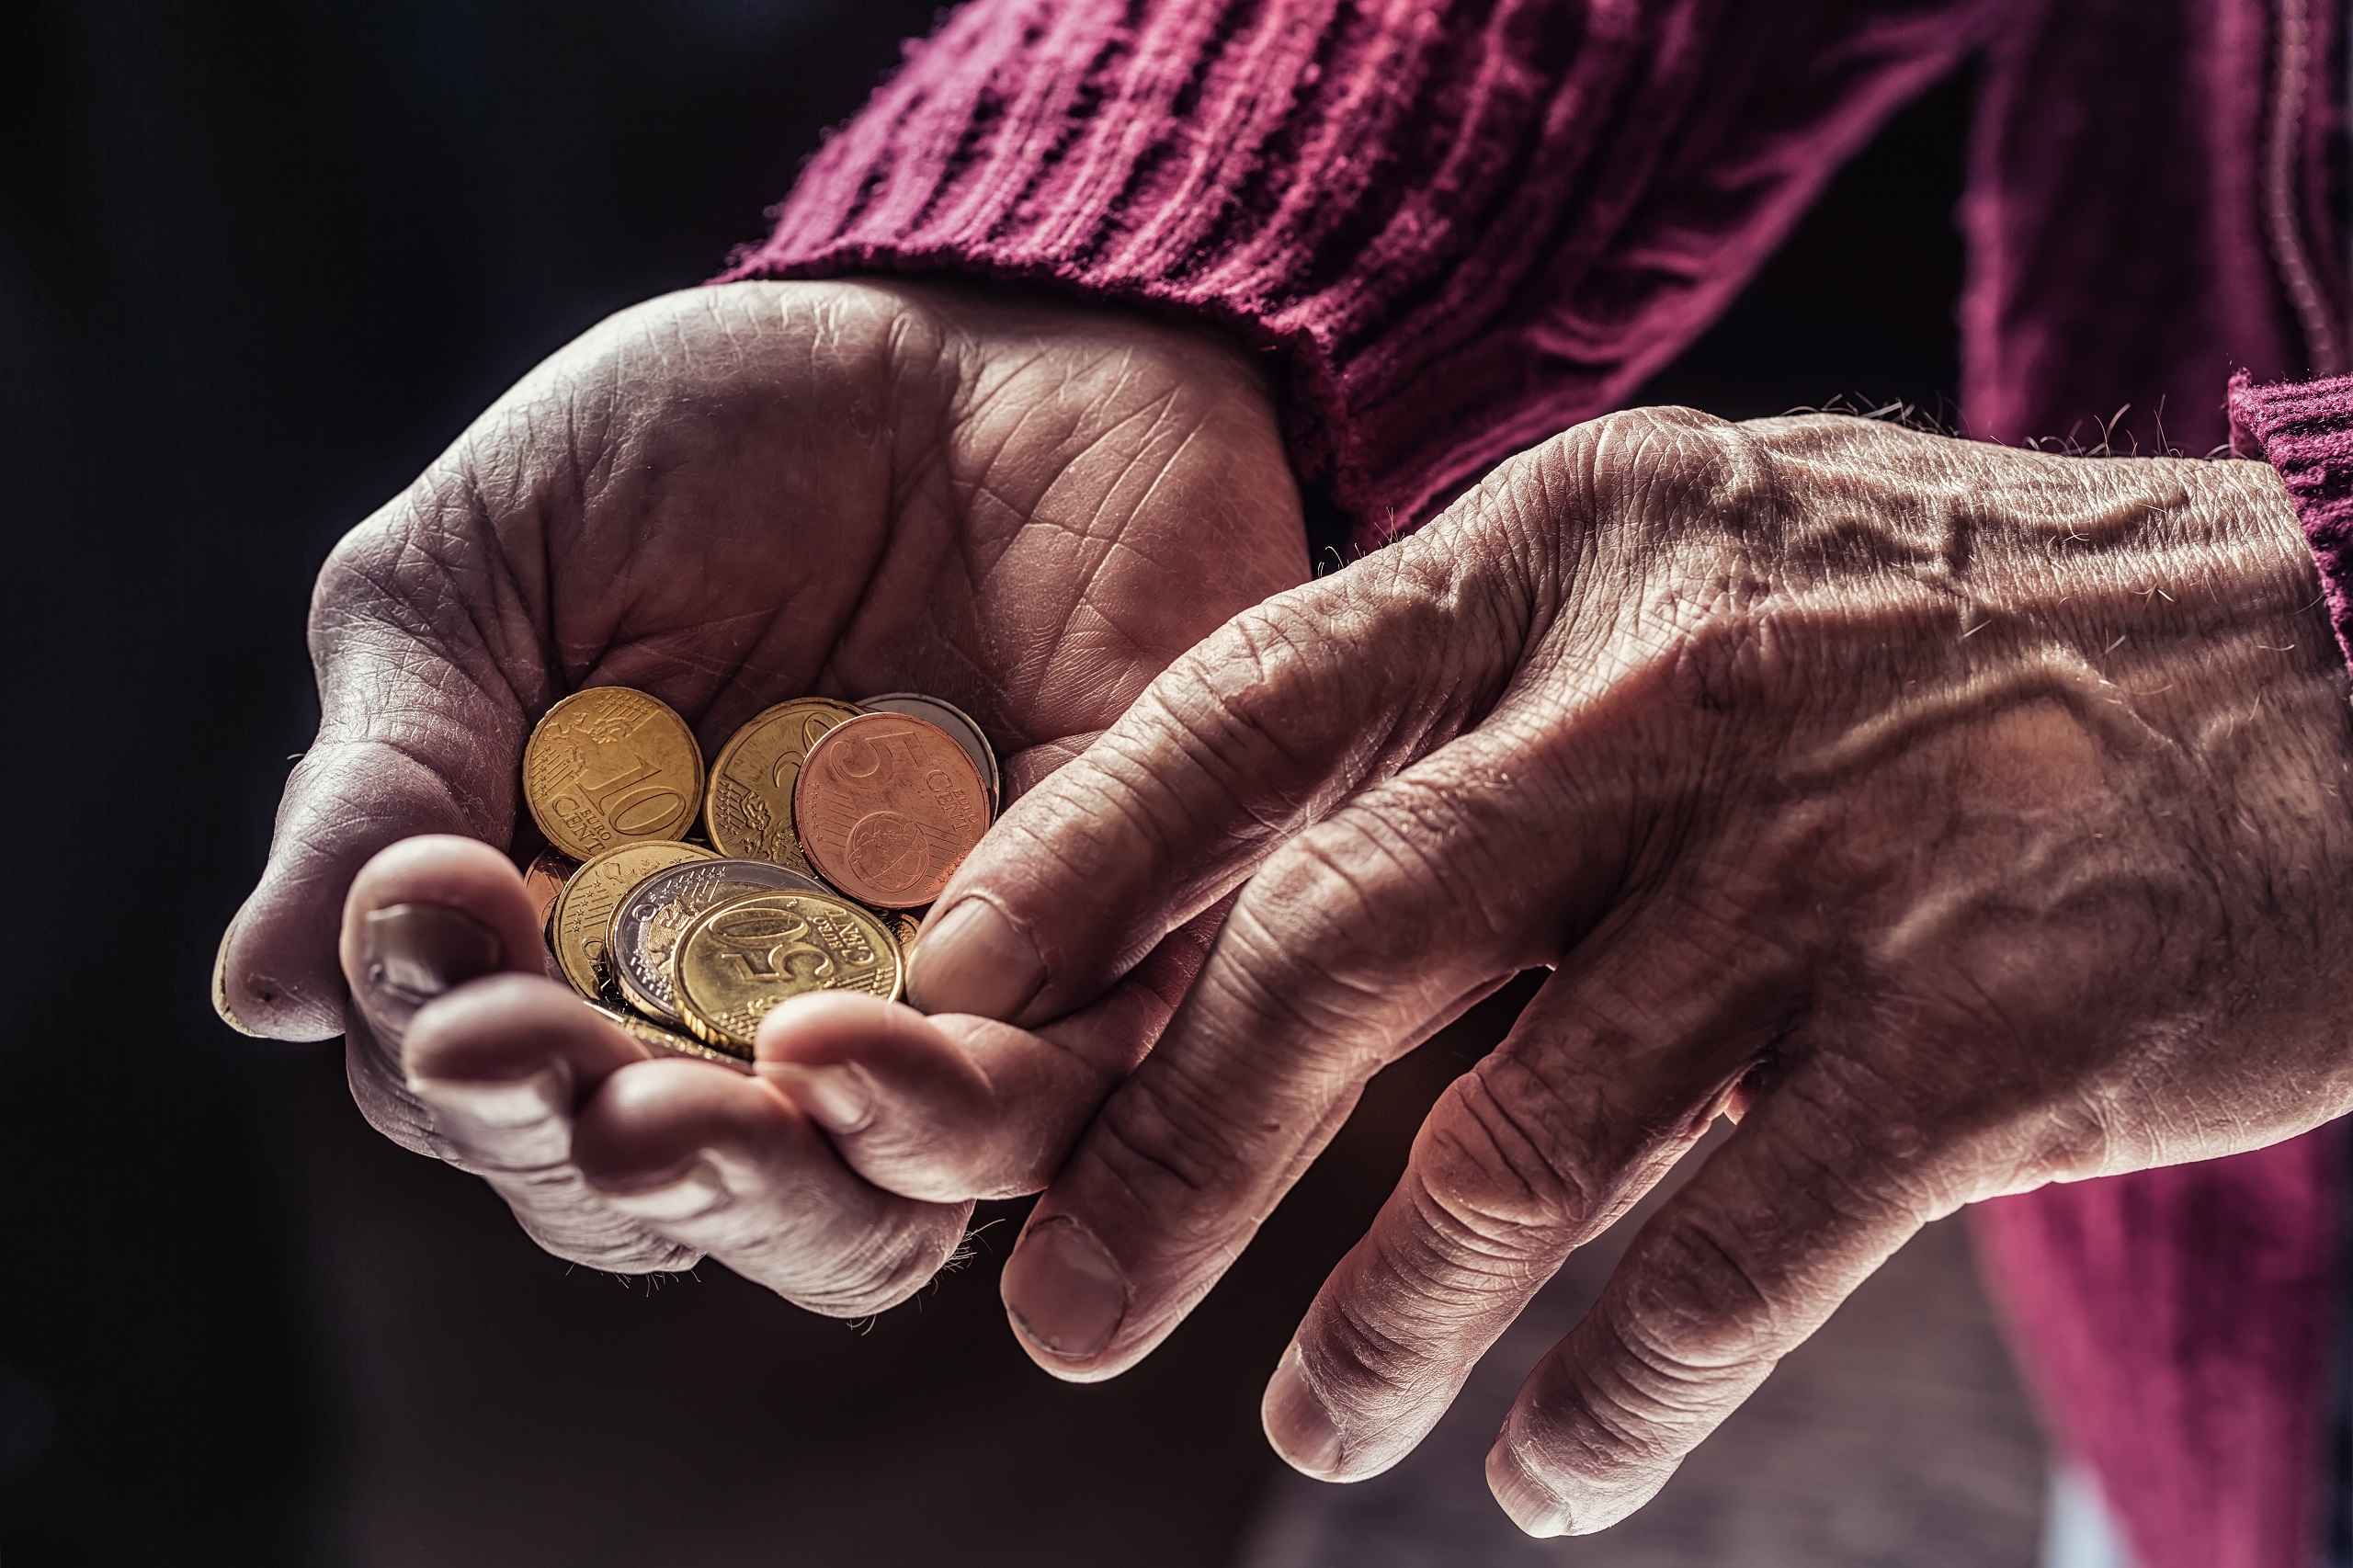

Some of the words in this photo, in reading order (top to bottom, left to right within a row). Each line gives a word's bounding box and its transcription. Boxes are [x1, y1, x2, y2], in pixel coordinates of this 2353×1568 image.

[551, 793, 607, 853] CENT
[575, 754, 687, 836] 10
[926, 769, 972, 833] CENT
[951, 788, 980, 824] EURO
[579, 807, 613, 842] EURO
[708, 907, 835, 983] 50
[812, 915, 844, 950] EURO
[824, 909, 876, 966] CENT
